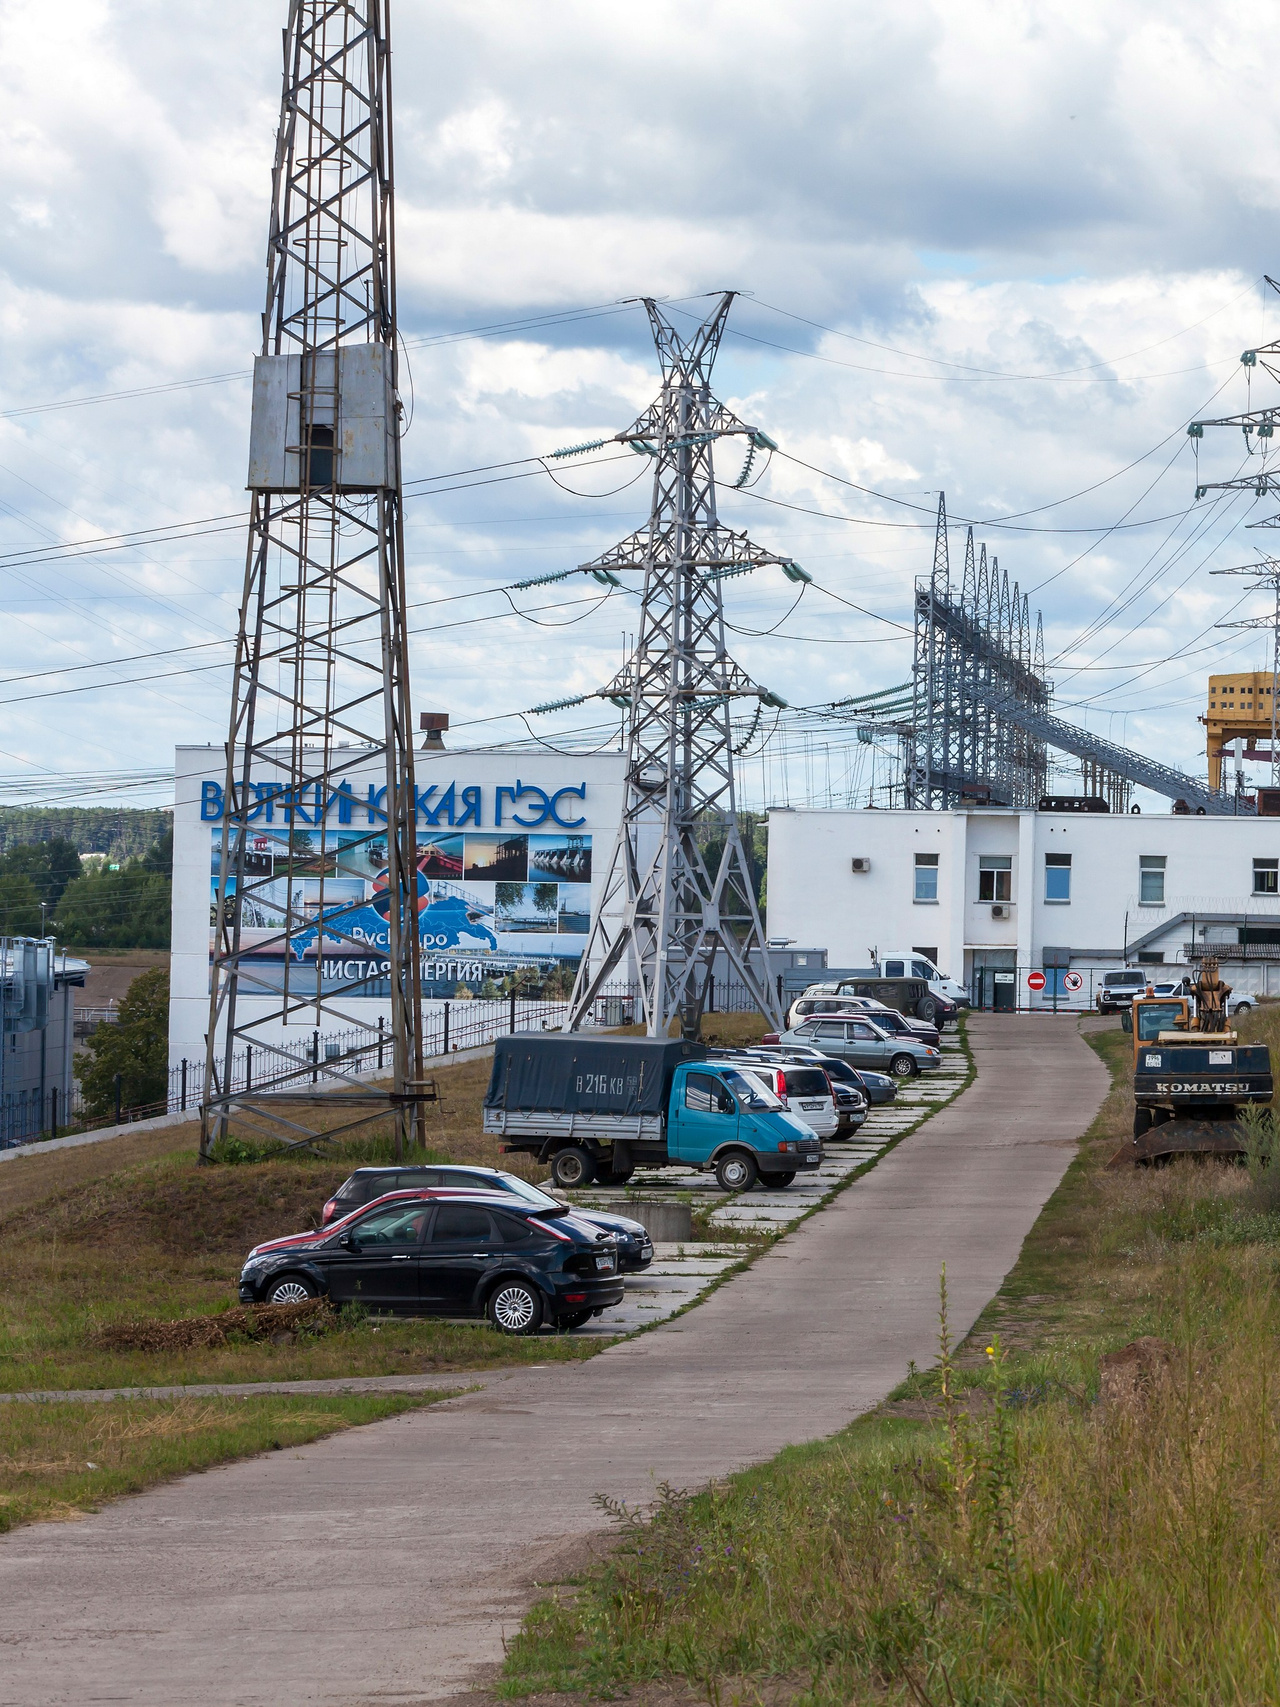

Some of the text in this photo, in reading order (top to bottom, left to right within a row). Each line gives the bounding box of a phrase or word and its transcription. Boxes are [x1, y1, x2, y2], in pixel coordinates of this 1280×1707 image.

[495, 779, 587, 828] ГЭС
[585, 1074, 607, 1094] 216
[1155, 1083, 1250, 1092] KOMATSU
